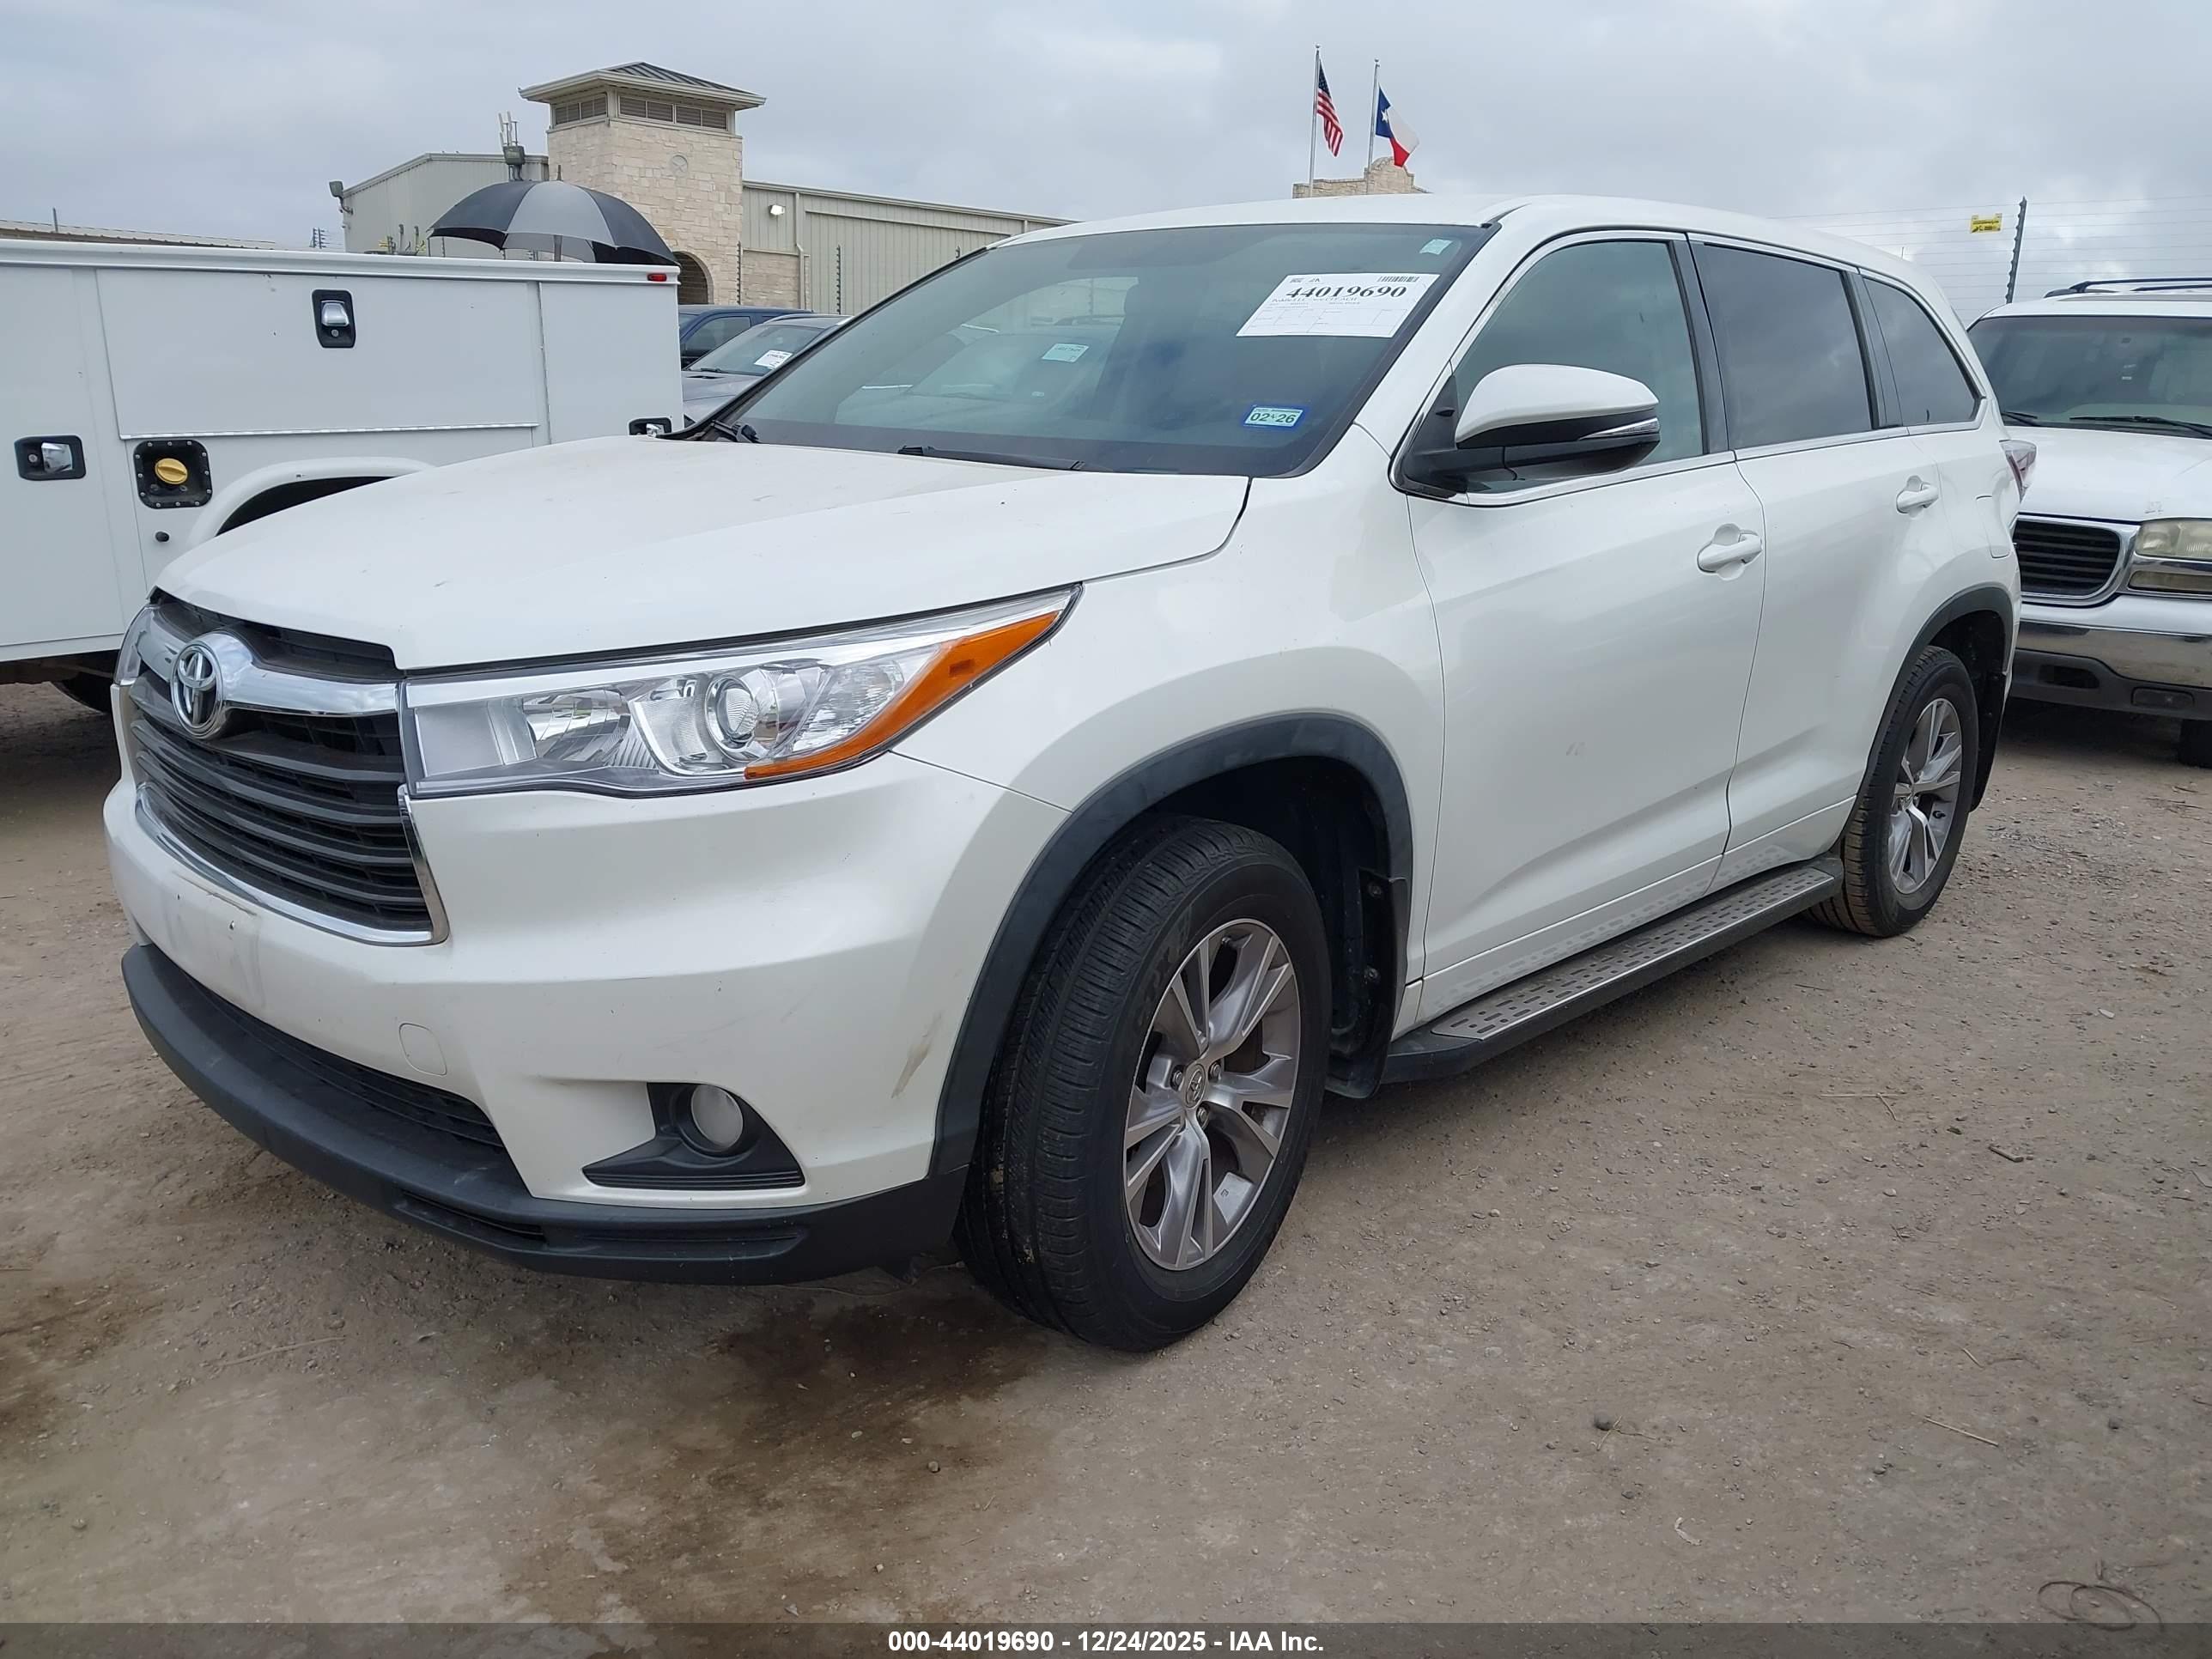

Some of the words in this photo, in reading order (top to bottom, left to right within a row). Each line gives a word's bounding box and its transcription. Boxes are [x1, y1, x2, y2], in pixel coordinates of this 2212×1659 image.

[1285, 285, 1407, 298] 44019690
[1250, 412, 1270, 422] 02
[1275, 413, 1297, 423] 26
